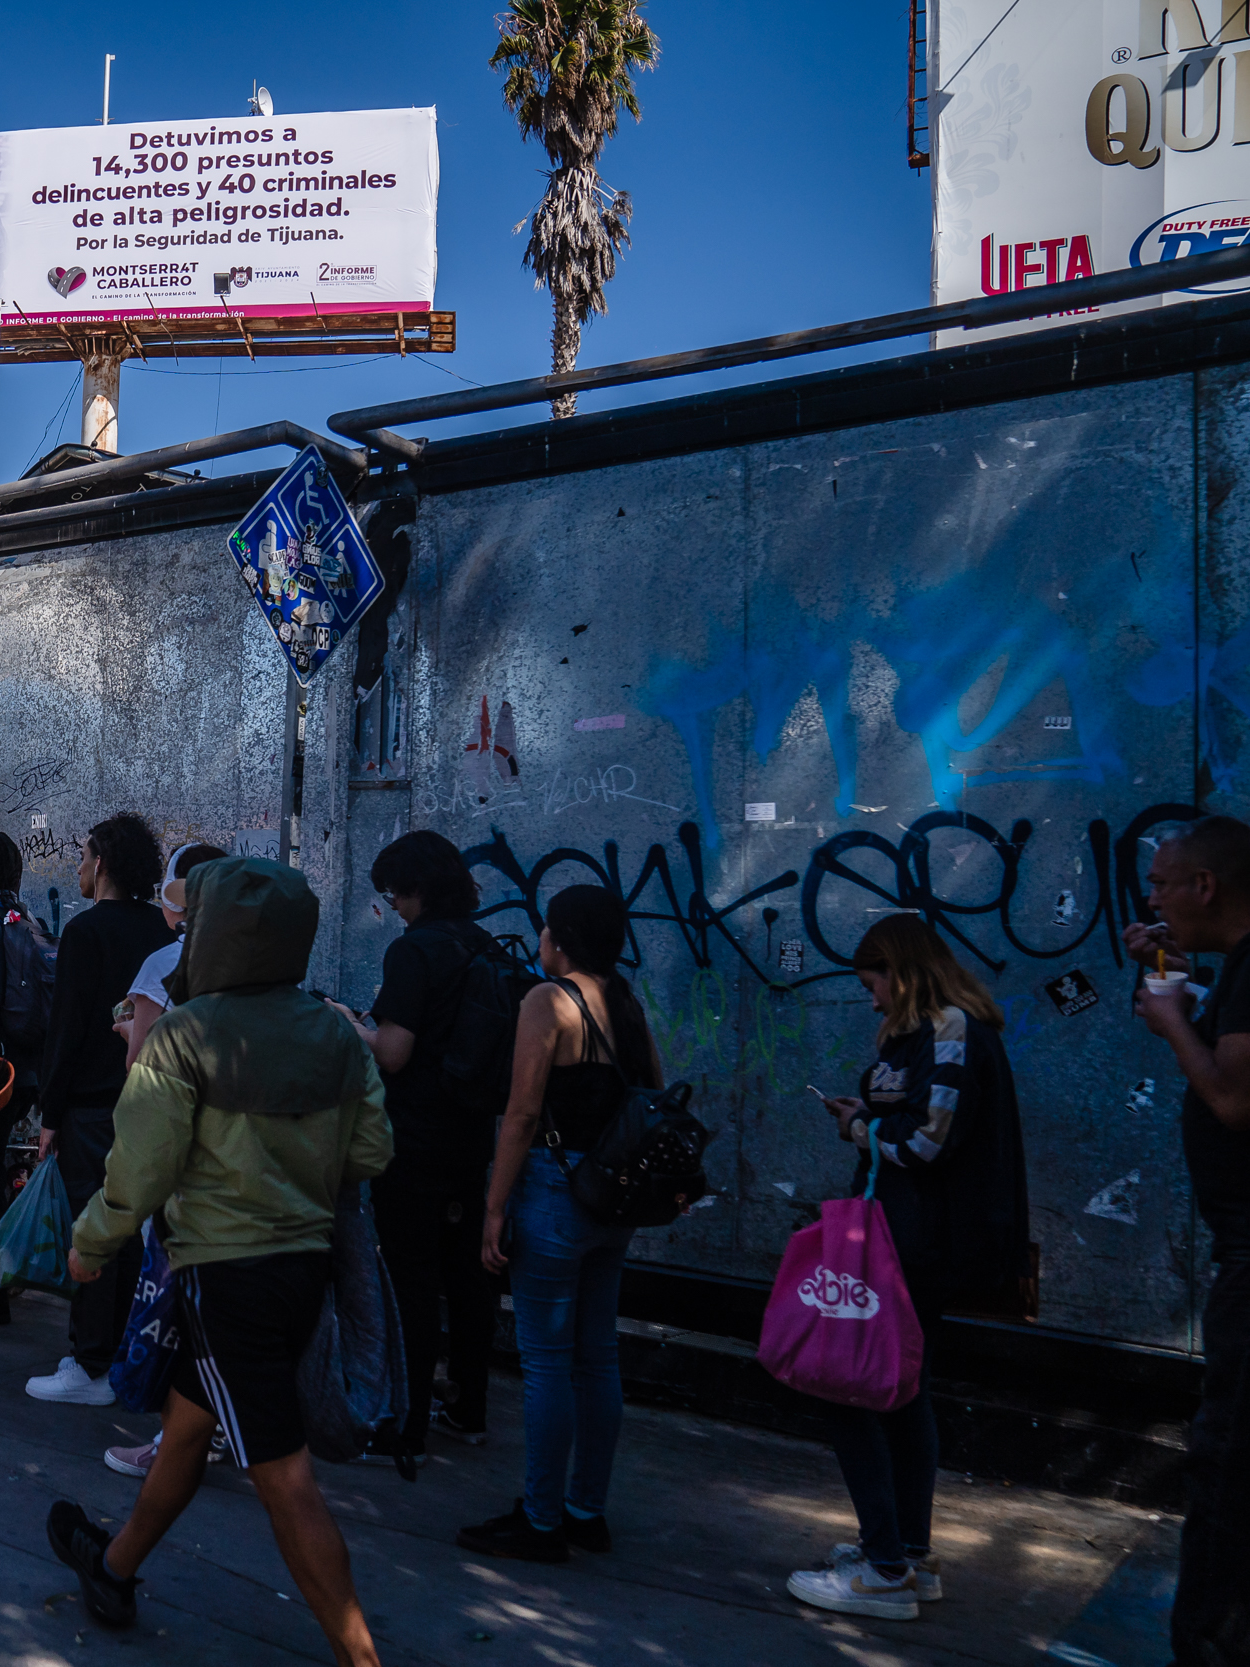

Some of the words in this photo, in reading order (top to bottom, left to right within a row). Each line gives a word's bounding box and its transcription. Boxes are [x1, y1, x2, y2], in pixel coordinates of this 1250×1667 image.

[130, 126, 274, 150] Detuvimos
[282, 127, 297, 143] a
[92, 151, 189, 178] 14,300
[198, 148, 334, 174] presuntos
[32, 180, 190, 205] delincuentes
[196, 180, 211, 200] y
[218, 172, 256, 195] 40
[262, 169, 397, 193] criminales
[72, 207, 104, 228] de
[113, 205, 164, 225] alta
[172, 196, 350, 228] peligrosidad.
[1162, 220, 1208, 233] DUTY
[1210, 216, 1250, 229] FREE
[76, 236, 109, 250] Por
[113, 234, 130, 249] la
[134, 229, 232, 252] Seguridad
[238, 230, 262, 245] de
[267, 226, 344, 247] Tijuana.
[254, 270, 300, 278] TIJUANA
[330, 266, 375, 275] INFORME
[981, 232, 1096, 296] UETA
[96, 275, 192, 290] CABALLERO
[6, 317, 44, 325] INFORME
[46, 316, 58, 324] DE
[60, 315, 105, 323] GOBIERNO
[113, 314, 121, 322] El
[123, 312, 154, 321] camino
